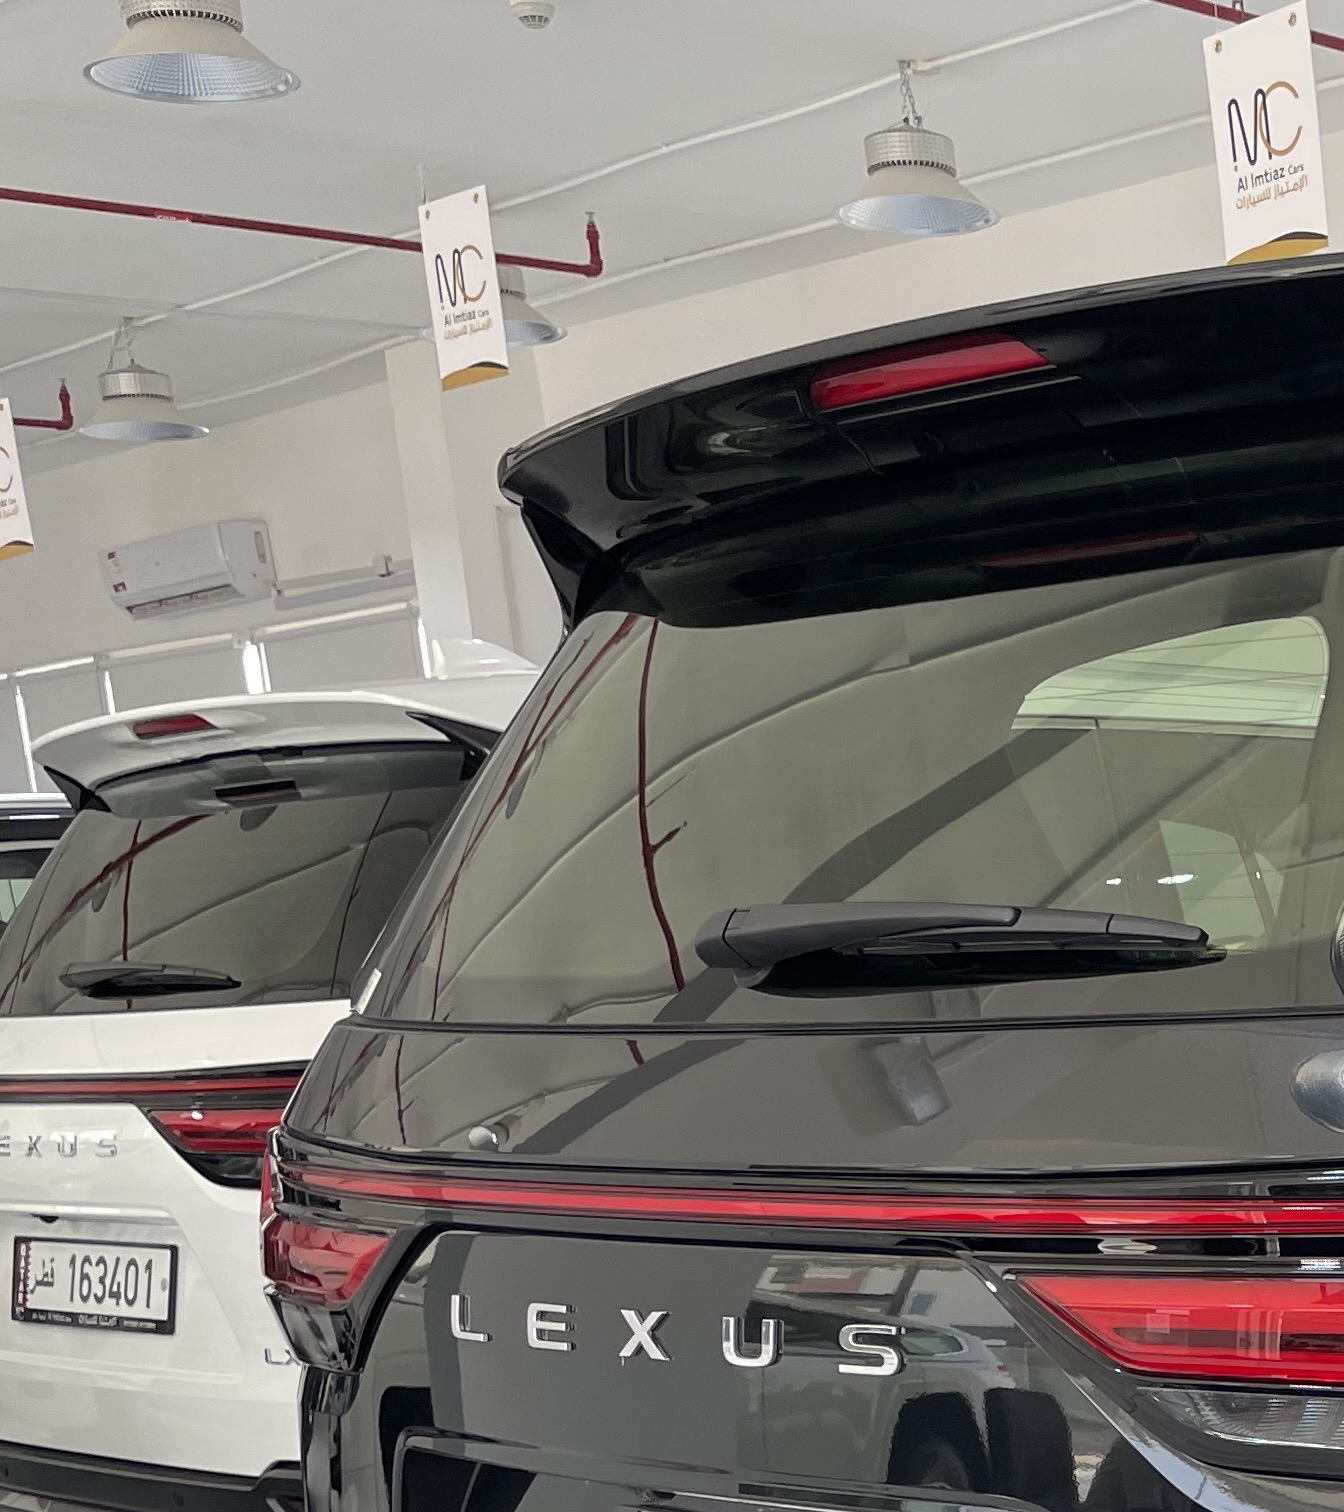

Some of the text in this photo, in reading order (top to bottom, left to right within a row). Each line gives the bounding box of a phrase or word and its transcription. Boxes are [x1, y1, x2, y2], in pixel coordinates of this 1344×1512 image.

[1237, 164, 1304, 193] Al Imtiaz Cars
[69, 1253, 154, 1309] 163401
[450, 1294, 907, 1376] LEXUS
